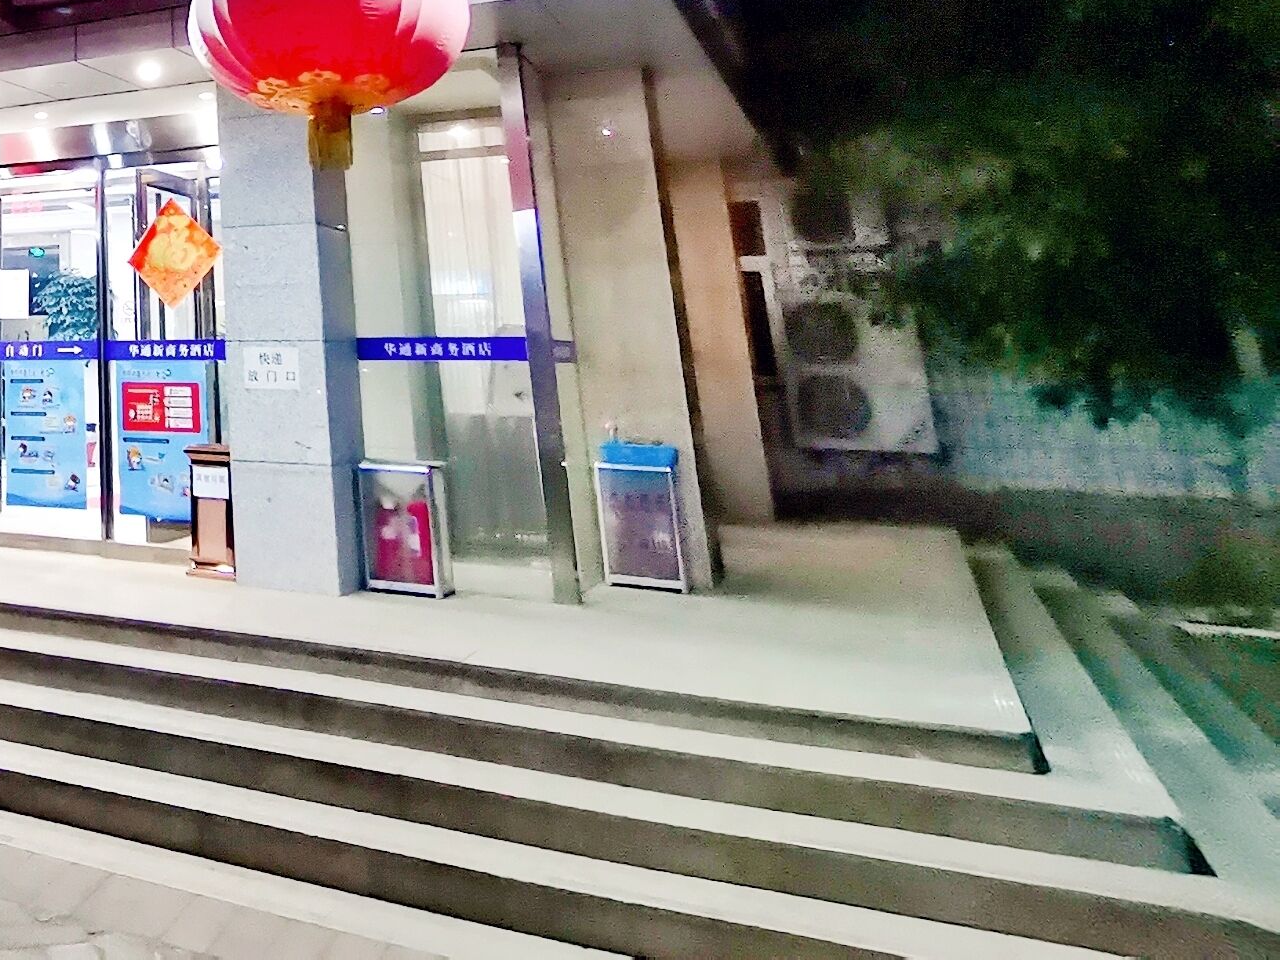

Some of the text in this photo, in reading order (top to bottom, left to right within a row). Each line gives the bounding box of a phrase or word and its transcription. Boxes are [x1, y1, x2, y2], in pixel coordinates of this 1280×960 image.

[5, 343, 43, 357] 自动门
[129, 343, 215, 358] 华通新商务酒店
[384, 342, 491, 357] 华通新商务酒店
